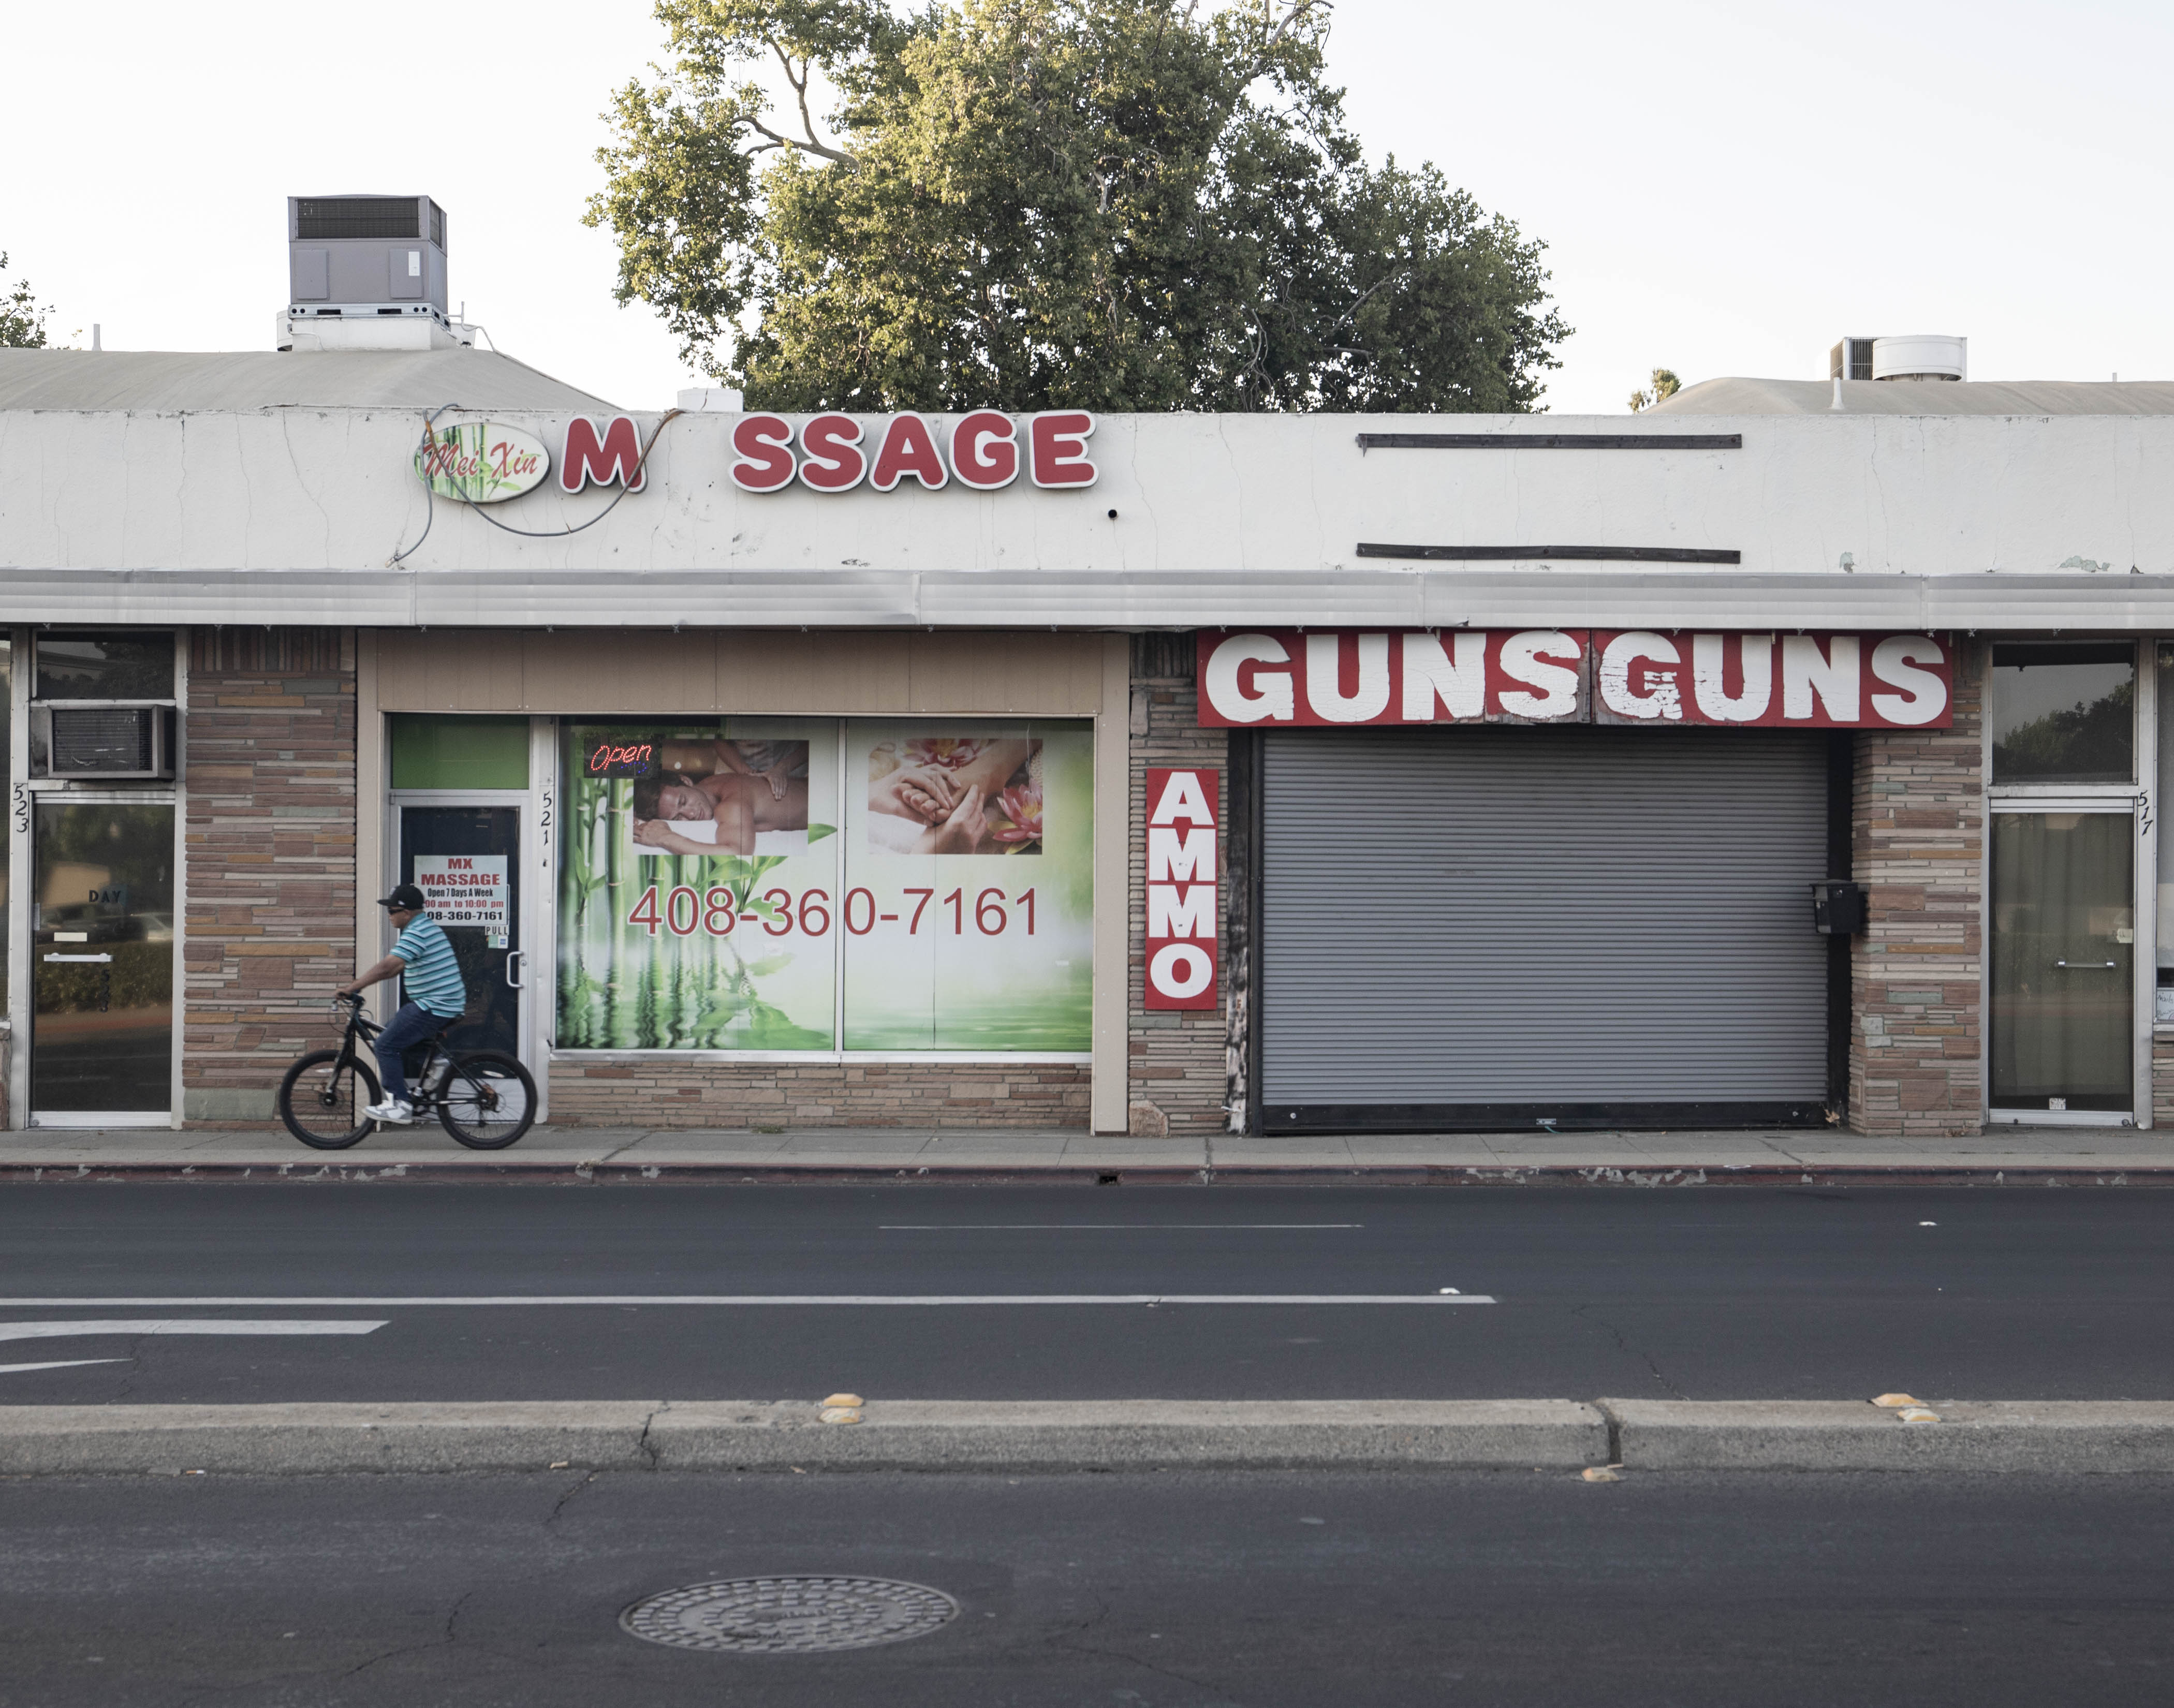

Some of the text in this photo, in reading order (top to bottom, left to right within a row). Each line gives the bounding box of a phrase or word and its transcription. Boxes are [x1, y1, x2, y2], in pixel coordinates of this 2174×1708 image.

[423, 441, 538, 478] Mei Xin
[590, 745, 652, 771] Open
[13, 783, 28, 833] 523
[2138, 790, 2153, 836] 517
[541, 791, 552, 846] 521
[448, 858, 473, 869] MX
[421, 874, 500, 885] MASSAGE
[1149, 772, 1216, 998] AMMO
[89, 890, 122, 903] DAY
[428, 888, 493, 898] Open 7 Days A Week
[465, 900, 487, 908] 10:00
[628, 886, 1035, 937] 408-360-7161
[427, 911, 503, 920] 08-360-7161
[486, 926, 508, 935] PULL
